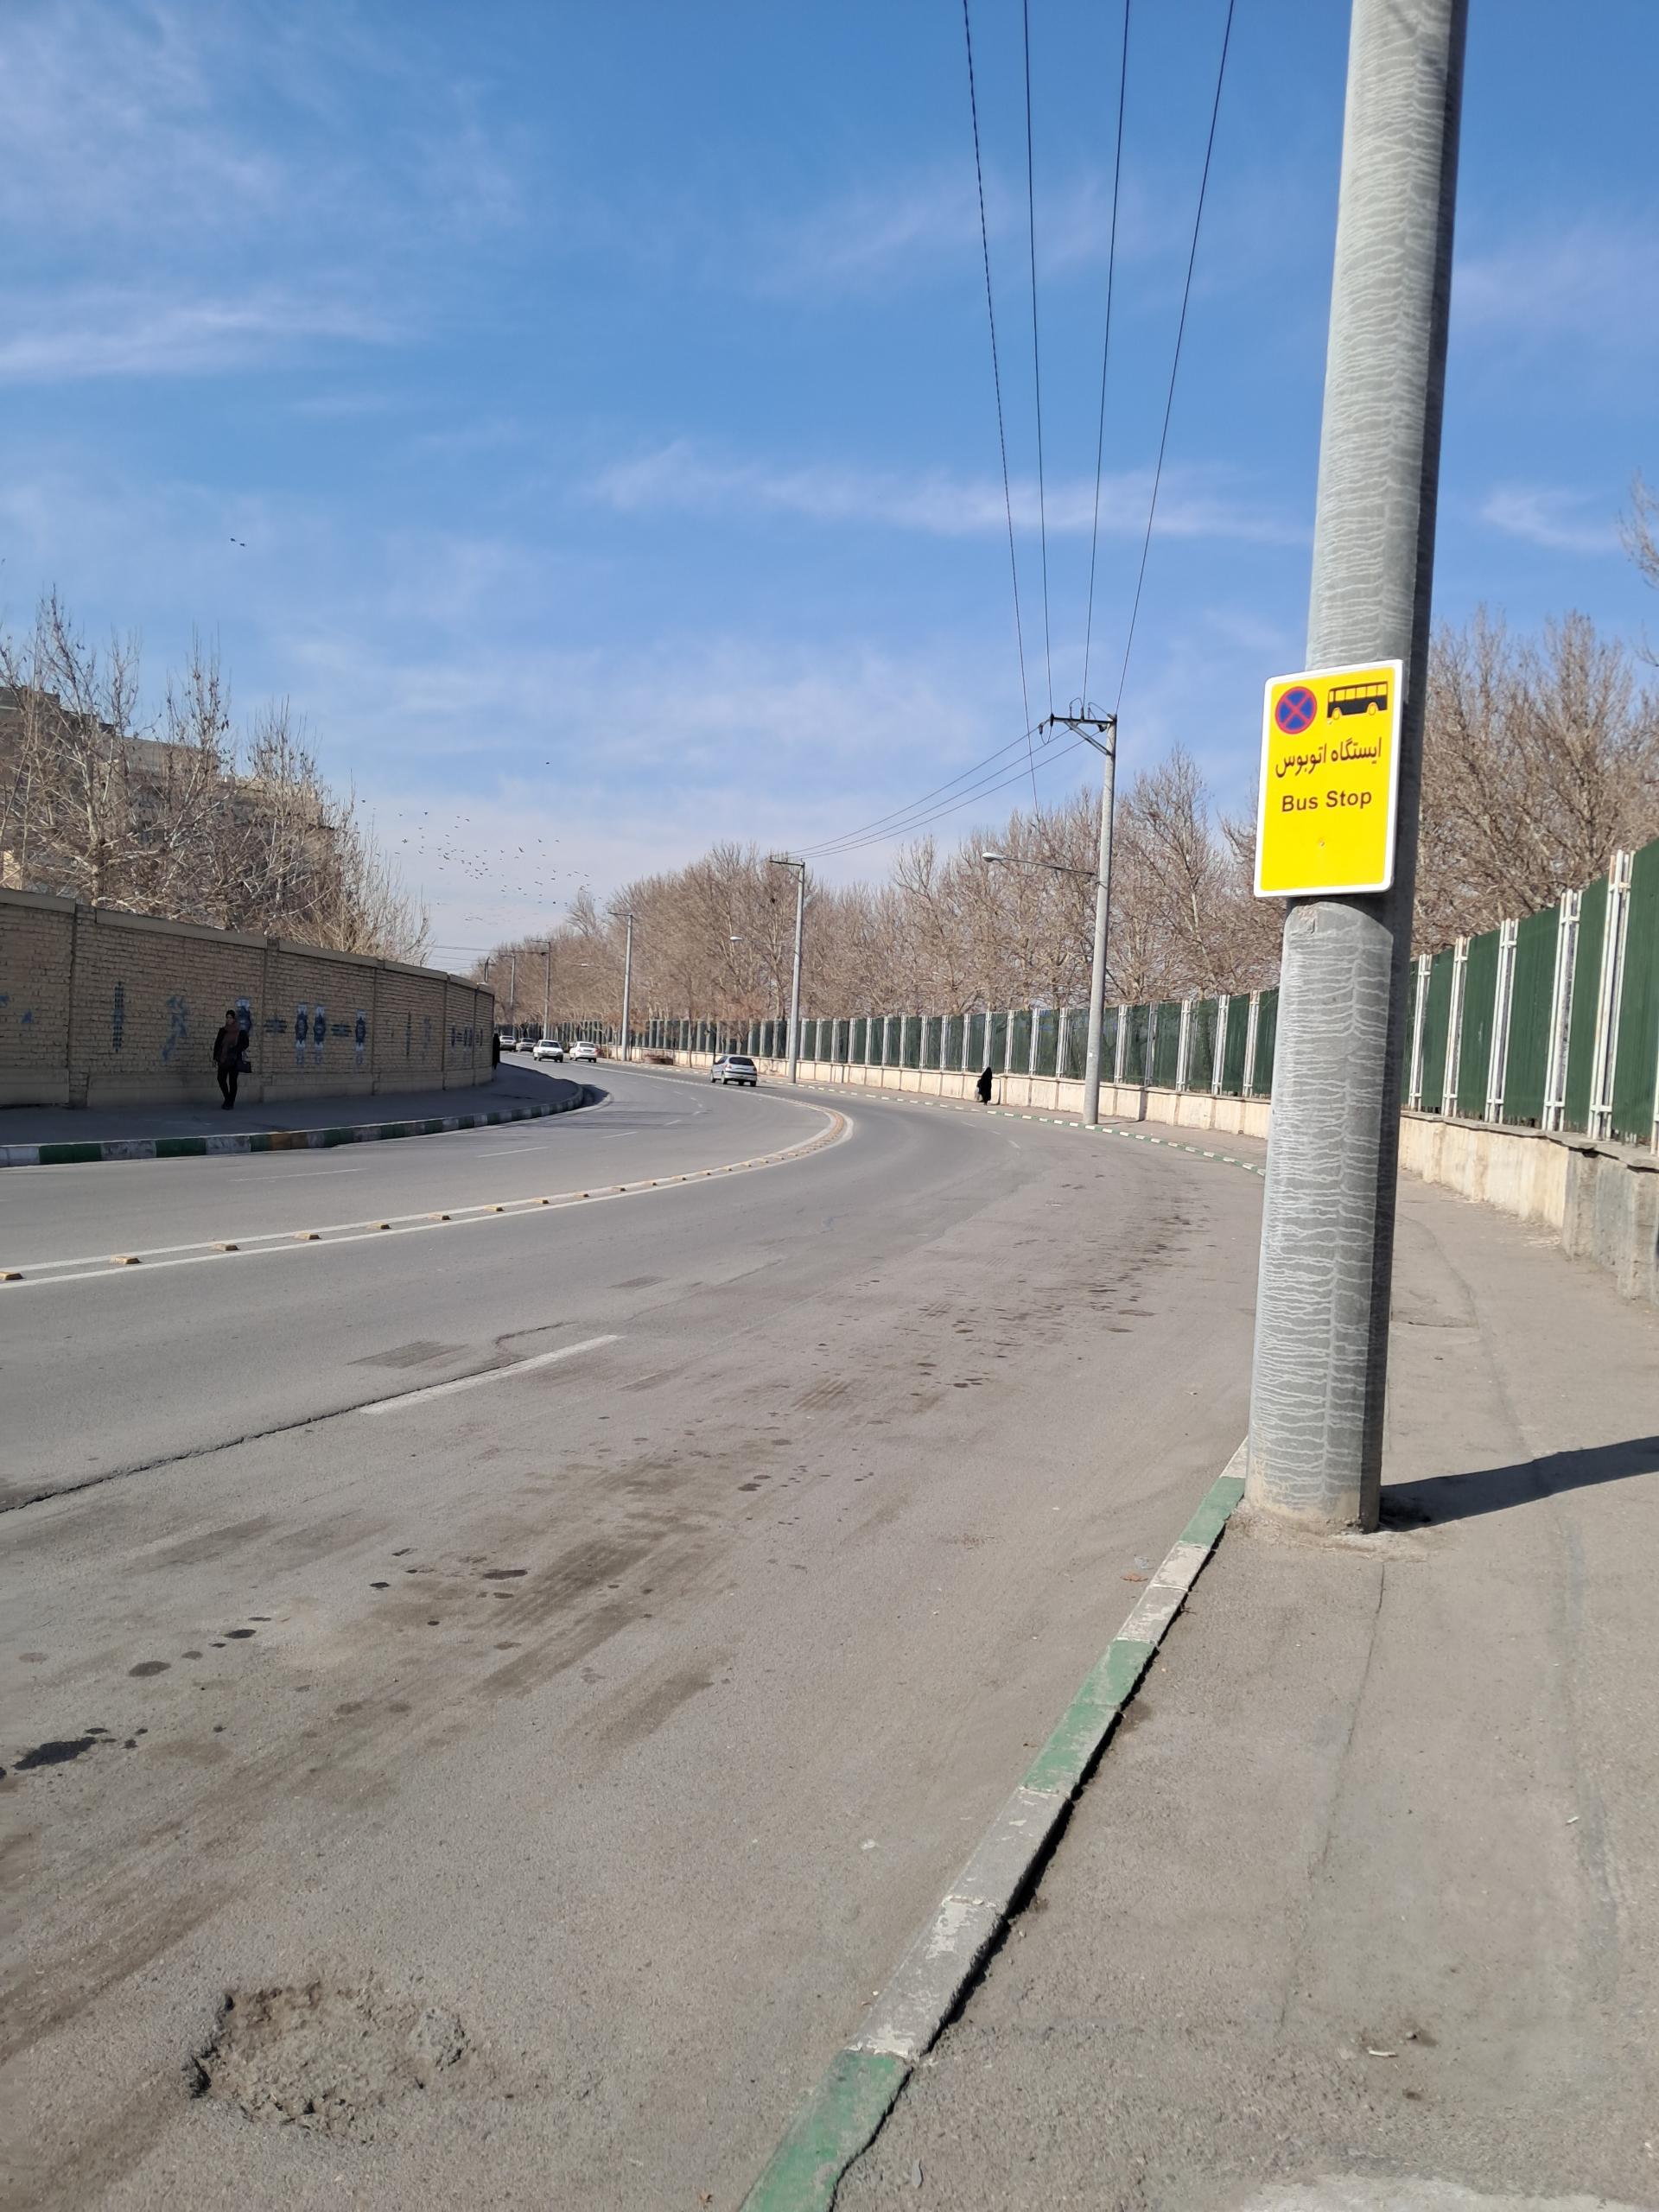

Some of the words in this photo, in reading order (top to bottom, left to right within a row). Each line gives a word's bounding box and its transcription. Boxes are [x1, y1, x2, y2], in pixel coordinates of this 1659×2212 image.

[1275, 744, 1327, 778] اتوبوس
[1331, 737, 1382, 764] ایستگاه
[1281, 795, 1319, 812] Bus
[1325, 790, 1372, 809] Stop
